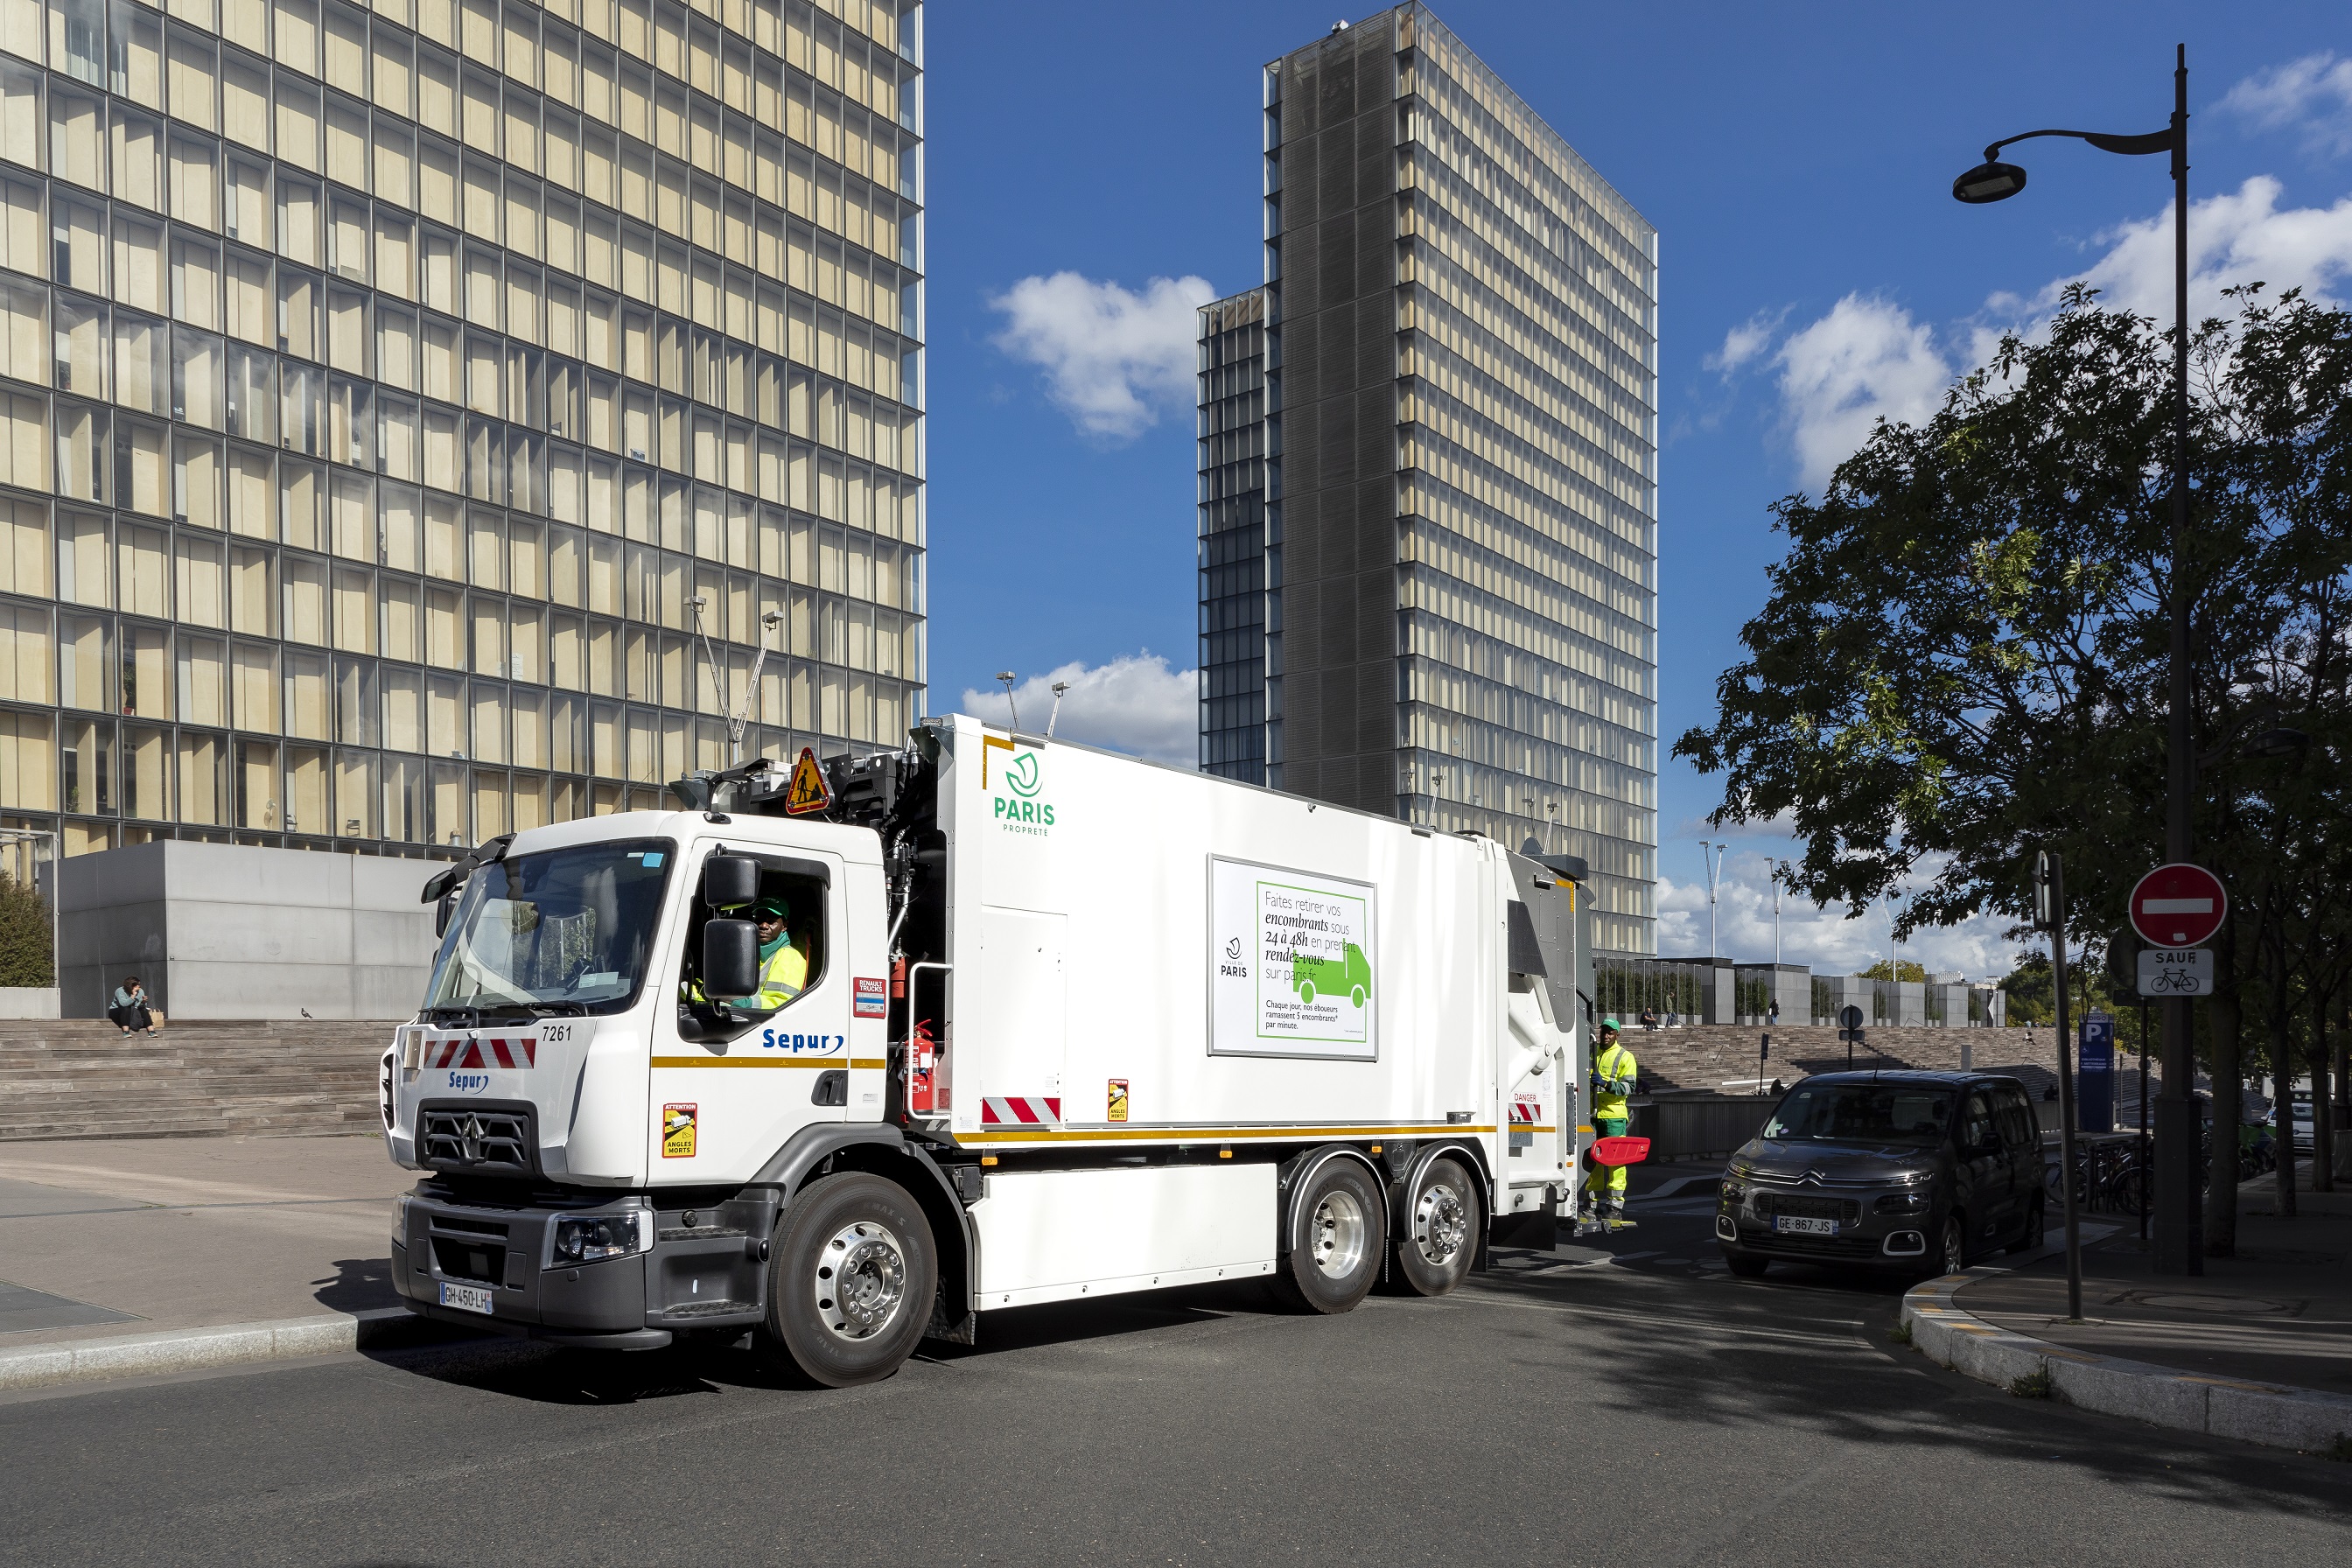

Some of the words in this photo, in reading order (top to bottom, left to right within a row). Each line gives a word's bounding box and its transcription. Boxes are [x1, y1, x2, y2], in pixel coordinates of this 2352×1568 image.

[995, 797, 1054, 825] PARIS
[1004, 824, 1048, 836] PROPRETÉ
[1265, 891, 1292, 909] Faites
[1295, 898, 1324, 914] retirer
[1326, 905, 1341, 917] vos
[1265, 913, 1328, 932] encombrants
[1331, 922, 1349, 934] sous
[1265, 931, 1278, 946] 24
[1280, 929, 1287, 944] à
[1290, 931, 1308, 948] 48h
[1311, 936, 1322, 948] en
[1325, 939, 1356, 954] prenant
[1265, 947, 1325, 967] rendez-vous
[2155, 952, 2196, 963] SAUF
[1221, 965, 1247, 978] PARIS
[1265, 968, 1282, 979] sur
[1284, 967, 1316, 984] paris.fr
[1265, 999, 1288, 1010] Chaque
[1289, 1003, 1302, 1012] jour,
[1313, 1004, 1338, 1013] éboueurs
[542, 1026, 571, 1041] 7261
[1265, 1021, 1276, 1030] par
[1277, 1021, 1298, 1030] minute.
[2086, 1024, 2102, 1042] P
[763, 1029, 830, 1053] Sepur
[449, 1072, 481, 1091] Sepur
[1514, 1093, 1536, 1102] DANGER
[1779, 1218, 1830, 1232] GE-867-JS
[445, 1286, 486, 1309] GH-450-LH
